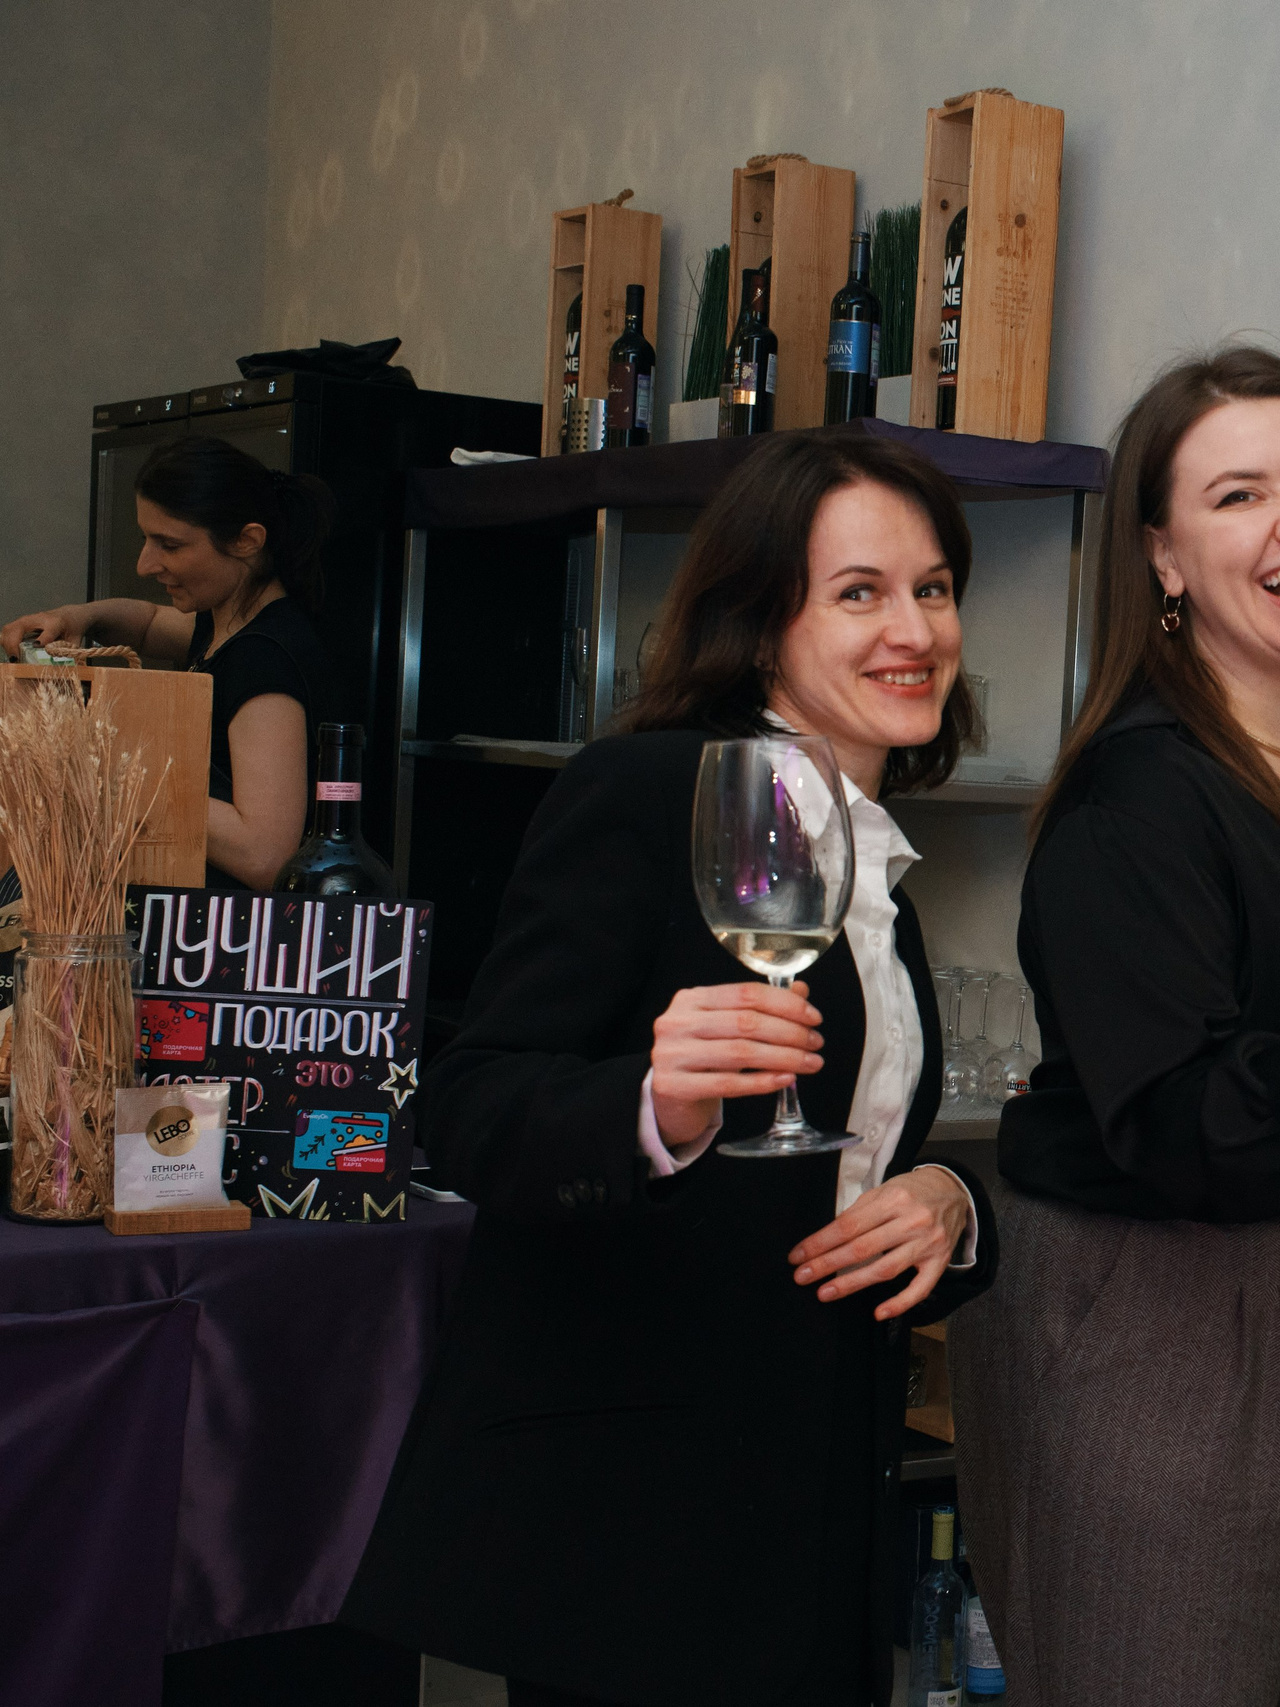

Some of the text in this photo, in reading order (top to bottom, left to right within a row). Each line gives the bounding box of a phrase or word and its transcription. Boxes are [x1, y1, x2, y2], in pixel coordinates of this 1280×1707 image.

[139, 893, 415, 999] ЛУЧШИЙ
[212, 1003, 398, 1058] ПОДАРОК
[295, 1062, 354, 1088] ЭТО
[153, 1119, 191, 1144] LEBO
[143, 1171, 205, 1182] YIRGACHEFFE
[151, 1163, 196, 1173] ETHIOPIA
